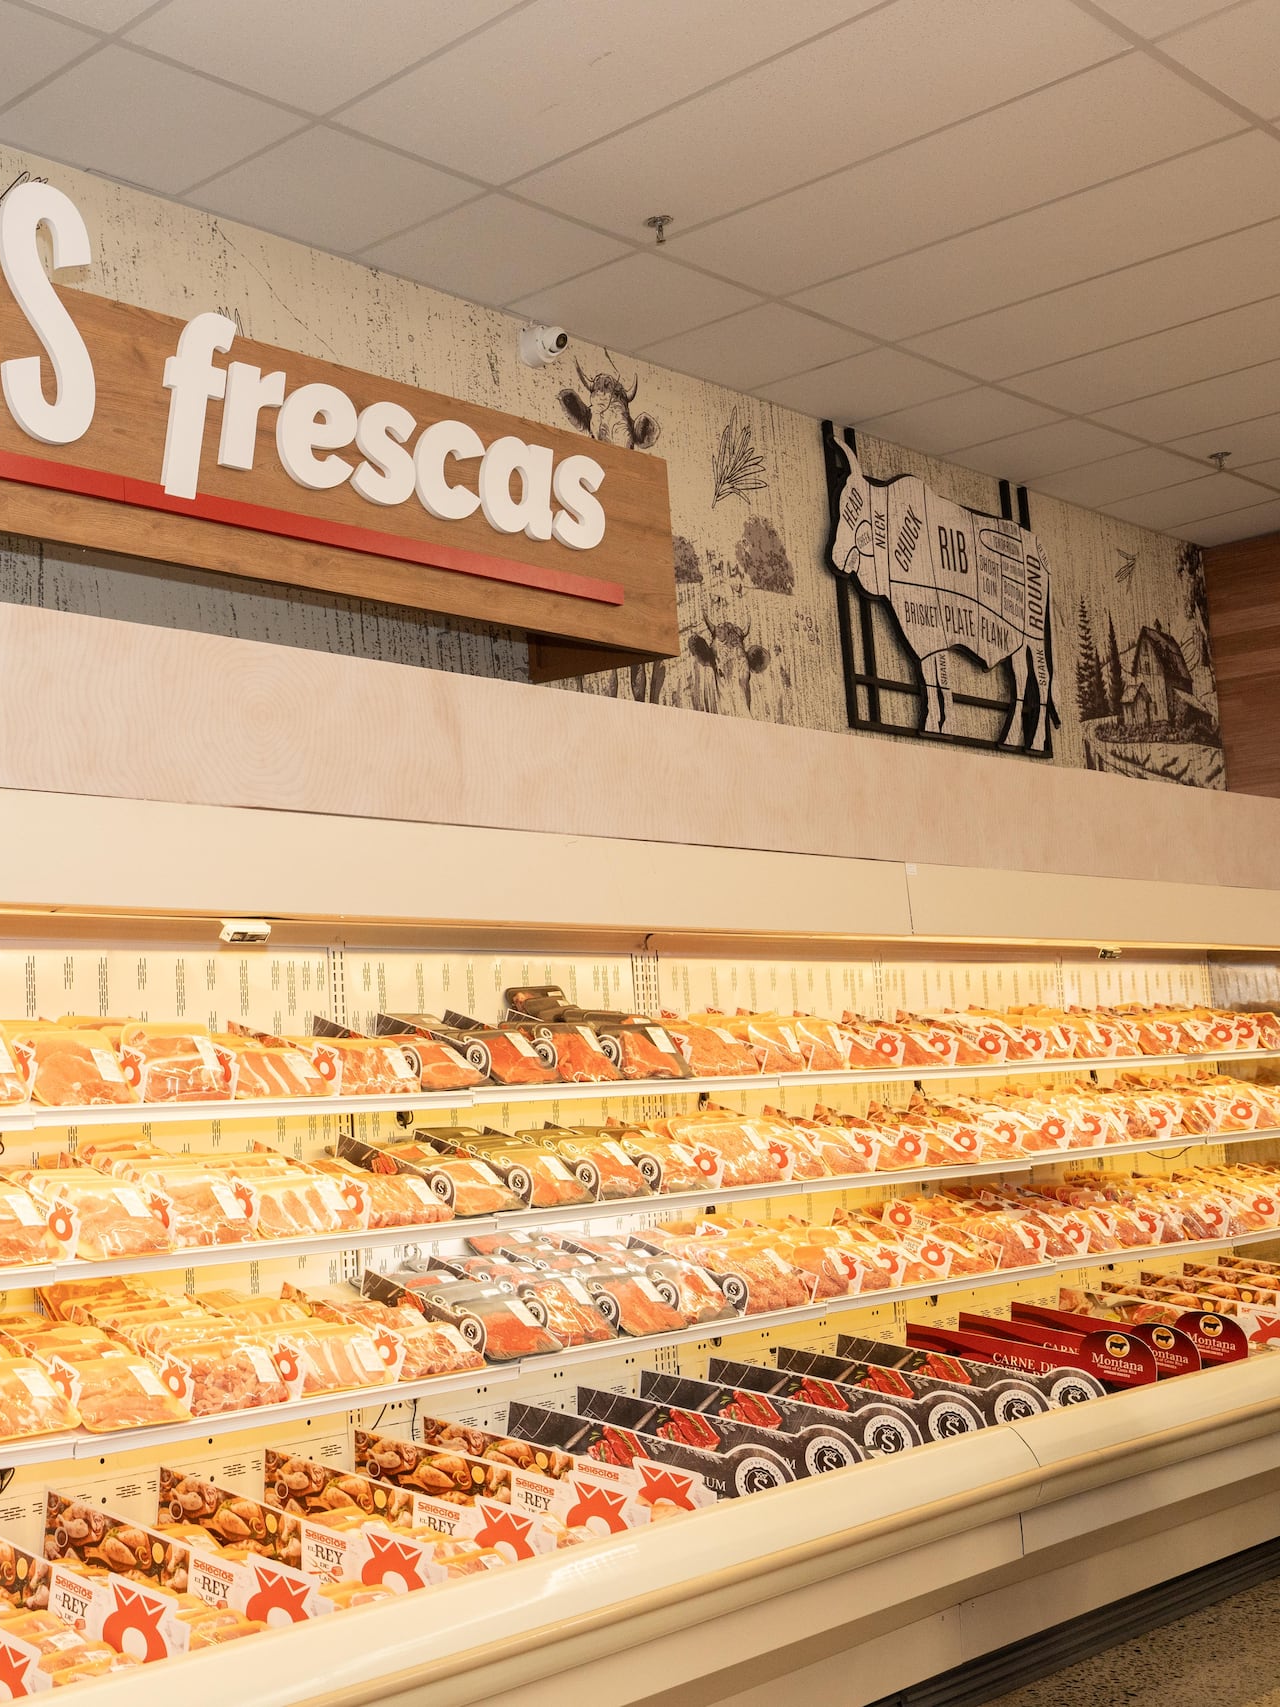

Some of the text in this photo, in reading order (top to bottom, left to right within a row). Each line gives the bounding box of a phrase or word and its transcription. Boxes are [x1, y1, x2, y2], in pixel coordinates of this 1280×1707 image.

[161, 312, 606, 550] frescas
[842, 487, 864, 531] HEAD
[874, 510, 886, 549] NECK
[894, 504, 923, 573] CHUCK
[938, 525, 969, 574] RIB
[979, 554, 1000, 574] SHORT
[982, 577, 998, 598] LOIN
[1027, 554, 1044, 632] ROUND
[905, 600, 940, 629] BRISKET
[945, 605, 976, 638] PLATE
[981, 616, 1010, 651] FLANK
[938, 653, 949, 686] SHANK
[1038, 648, 1048, 687] SHANK
[1187, 1331, 1236, 1352] Montana
[992, 1352, 1058, 1373] CARNE DE
[1091, 1352, 1144, 1373] Montana
[1153, 1349, 1189, 1365] ontana
[577, 1463, 620, 1482] Selectos
[515, 1477, 556, 1496] Selectos
[418, 1501, 461, 1521] Selectos
[523, 1491, 552, 1512] REY
[427, 1515, 457, 1537] REY
[305, 1528, 347, 1550] Selectos
[314, 1543, 343, 1566] REY
[193, 1558, 234, 1583] Selectos
[55, 1574, 93, 1600] Selectos
[201, 1575, 230, 1599] REY
[61, 1592, 89, 1618] REY
